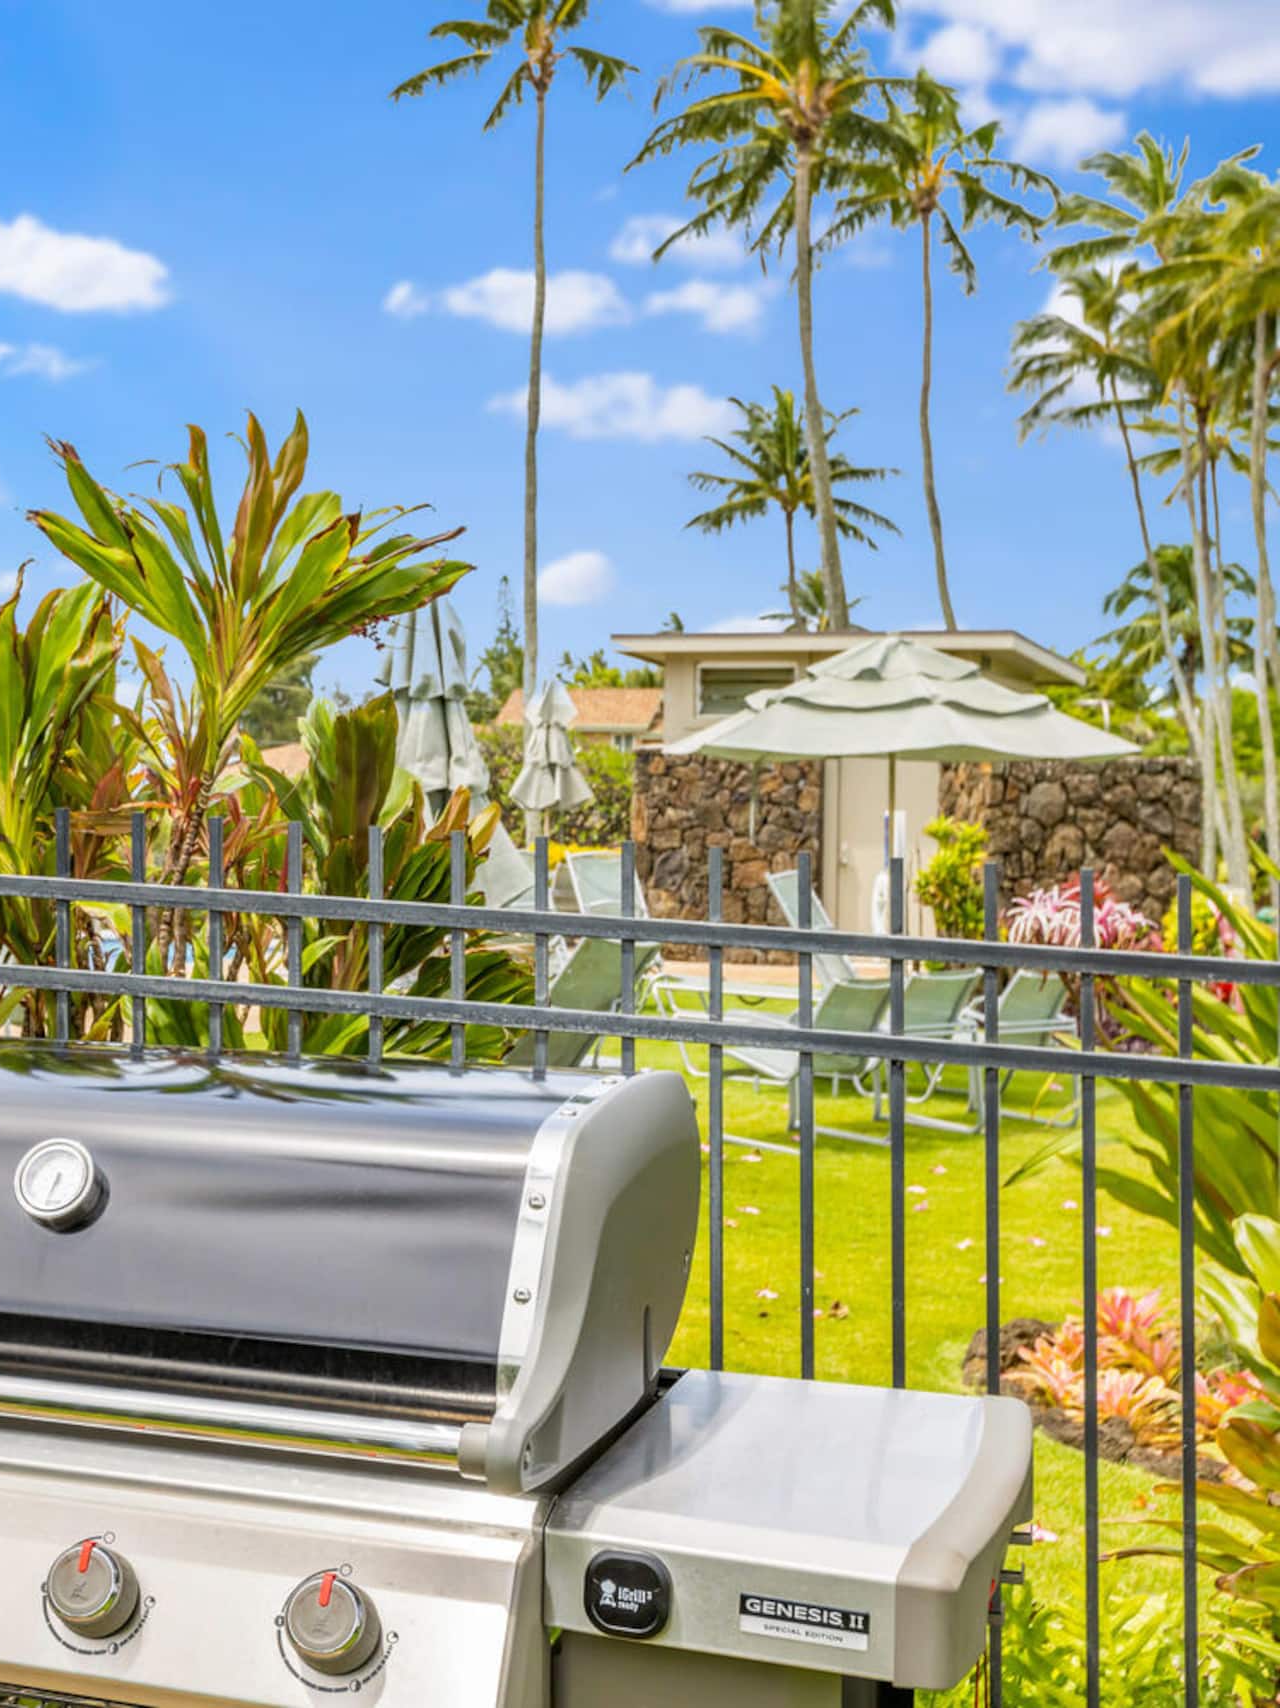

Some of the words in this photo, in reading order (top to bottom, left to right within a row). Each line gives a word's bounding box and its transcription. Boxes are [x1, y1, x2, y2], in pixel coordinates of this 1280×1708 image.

[745, 1598, 843, 1626] GENESIS
[849, 1614, 865, 1630] II
[763, 1623, 801, 1636] SPECIAL
[805, 1631, 844, 1643] EDITION
